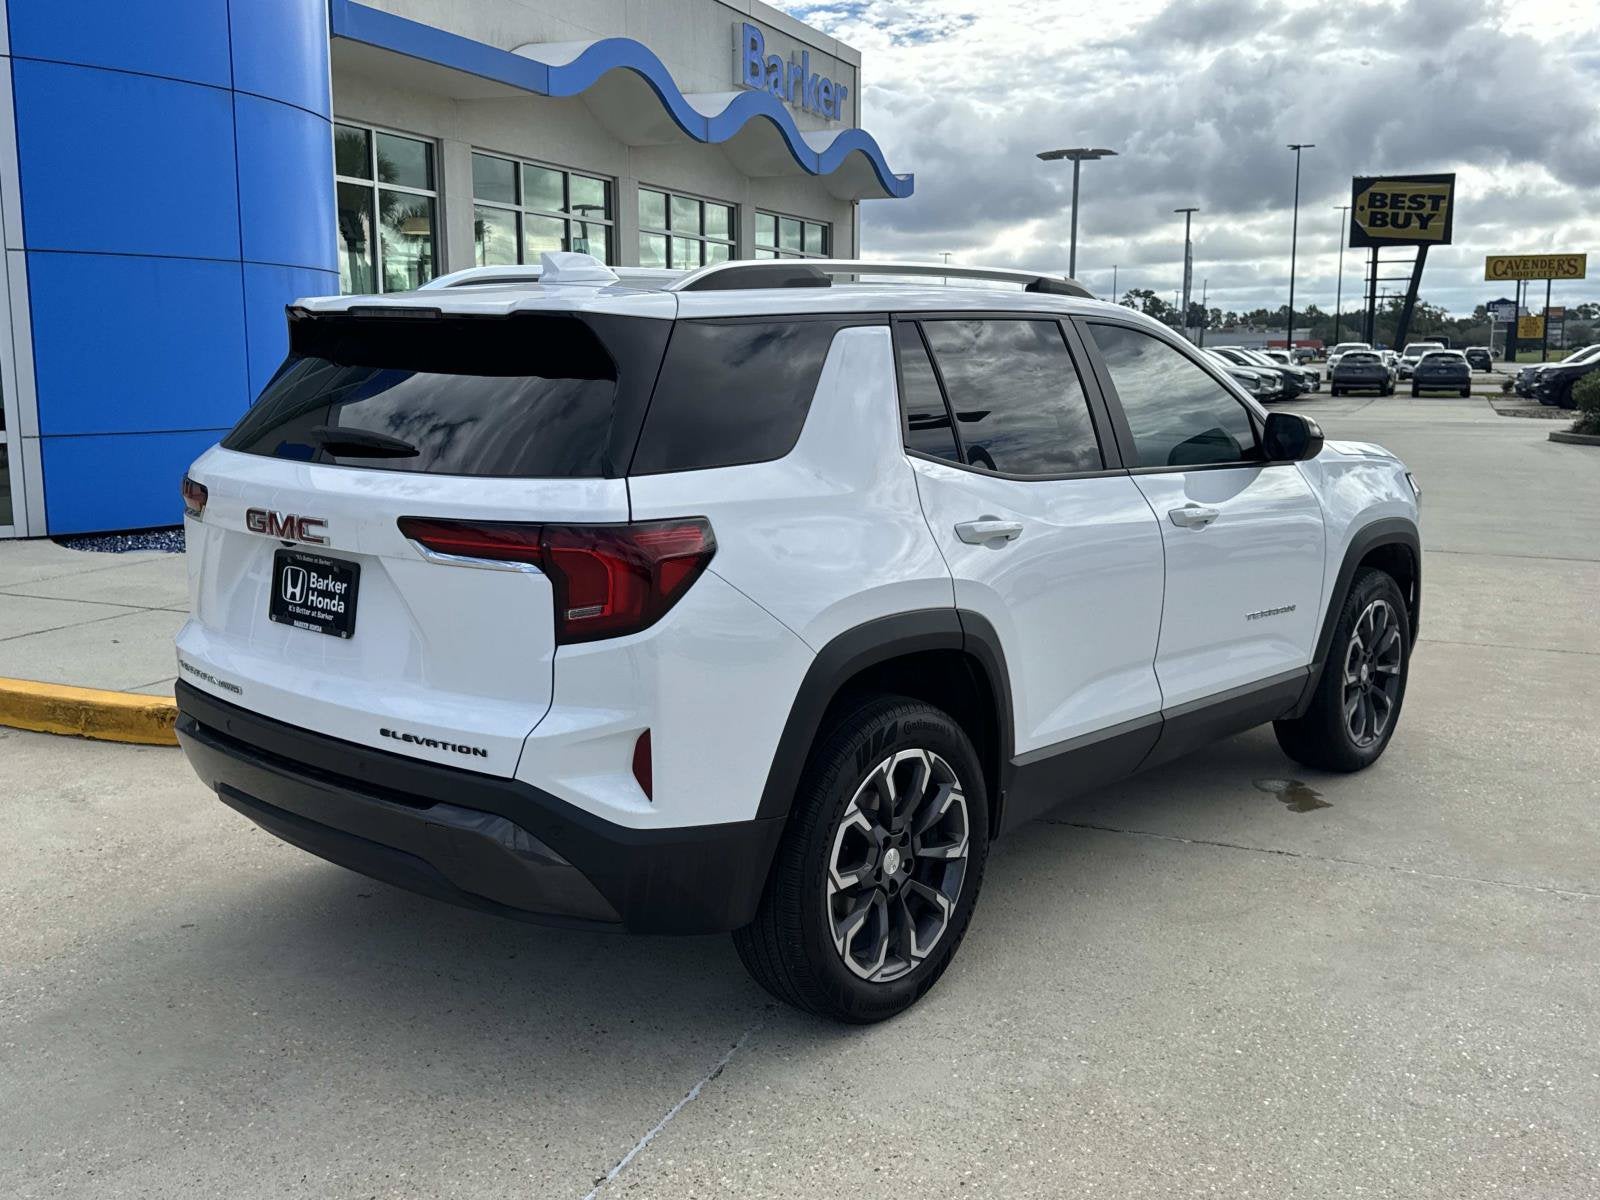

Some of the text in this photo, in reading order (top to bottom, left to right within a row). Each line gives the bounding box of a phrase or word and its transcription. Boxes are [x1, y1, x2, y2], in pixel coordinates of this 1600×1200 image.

[743, 22, 848, 121] Barker
[1368, 192, 1446, 211] BEST
[1368, 211, 1436, 230] BUY
[1493, 258, 1578, 277] CAVENDER'S
[246, 507, 330, 546] GMC
[310, 572, 347, 594] Barker
[308, 590, 345, 613] Honda
[296, 606, 311, 615] Better
[317, 611, 334, 621] Barker
[379, 727, 488, 758] ELEVATION
